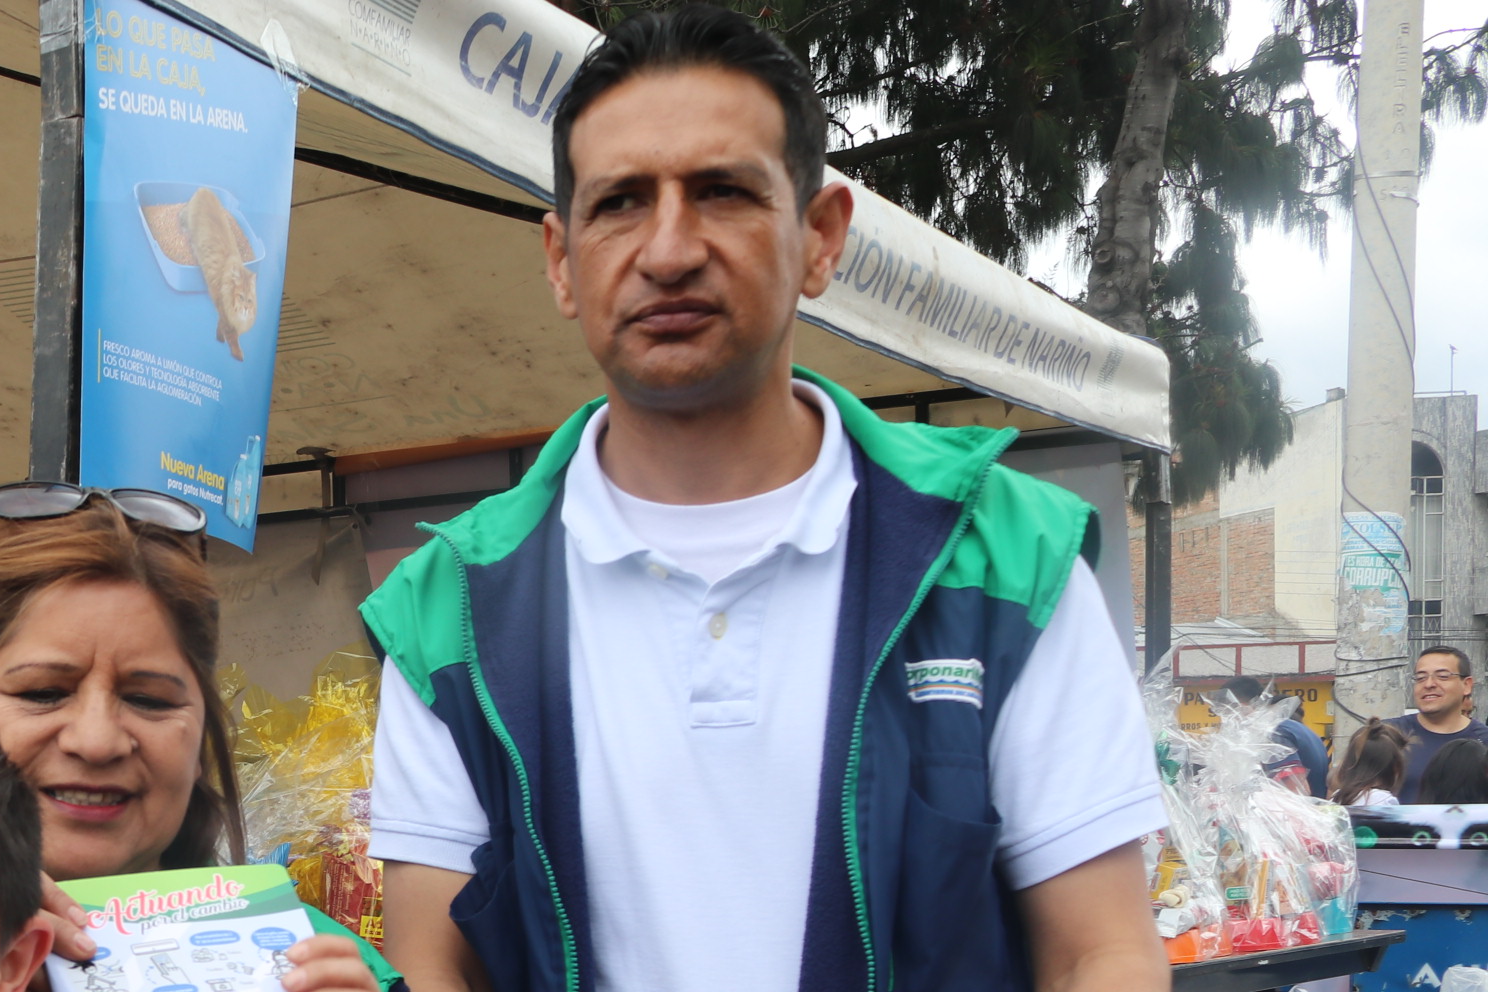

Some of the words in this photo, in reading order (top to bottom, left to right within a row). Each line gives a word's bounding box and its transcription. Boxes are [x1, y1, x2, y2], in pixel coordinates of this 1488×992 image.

[95, 8, 123, 38] LO
[128, 15, 167, 49] QUE
[171, 26, 216, 62] PASA
[96, 44, 123, 74] EN
[129, 50, 152, 80] LA
[156, 57, 206, 96] CAJA,
[98, 87, 116, 110] SE
[119, 90, 167, 118] QUEDA
[170, 99, 186, 122] EN
[189, 103, 204, 125] LA
[207, 106, 249, 133] ARENA.
[895, 261, 1004, 354] FAMILIAR
[992, 314, 1031, 367] DE
[1020, 326, 1093, 393] NARIÑO
[103, 340, 130, 357] FRESCO
[131, 349, 157, 366] AROMA
[157, 357, 162, 367] A
[163, 358, 183, 373] LIMÓN
[183, 366, 195, 377] QUE
[195, 369, 223, 390] CONTROLA
[103, 353, 118, 367] LOS
[118, 356, 145, 374] OLORES
[145, 365, 151, 376] Y
[151, 366, 188, 388] TECNOLOGÍA
[188, 379, 221, 401] ABSORBENTE
[103, 366, 120, 380] QUE
[120, 370, 147, 388] FACILITA
[147, 378, 157, 390] LA
[161, 451, 196, 480] Nueva
[197, 464, 225, 491] Arena
[167, 478, 184, 493] para
[183, 482, 199, 498] gatos
[199, 487, 224, 506] Nutrecat.
[86, 873, 245, 935] Actuando
[140, 915, 169, 936] por
[172, 908, 189, 923] el
[190, 899, 250, 918] cambio
